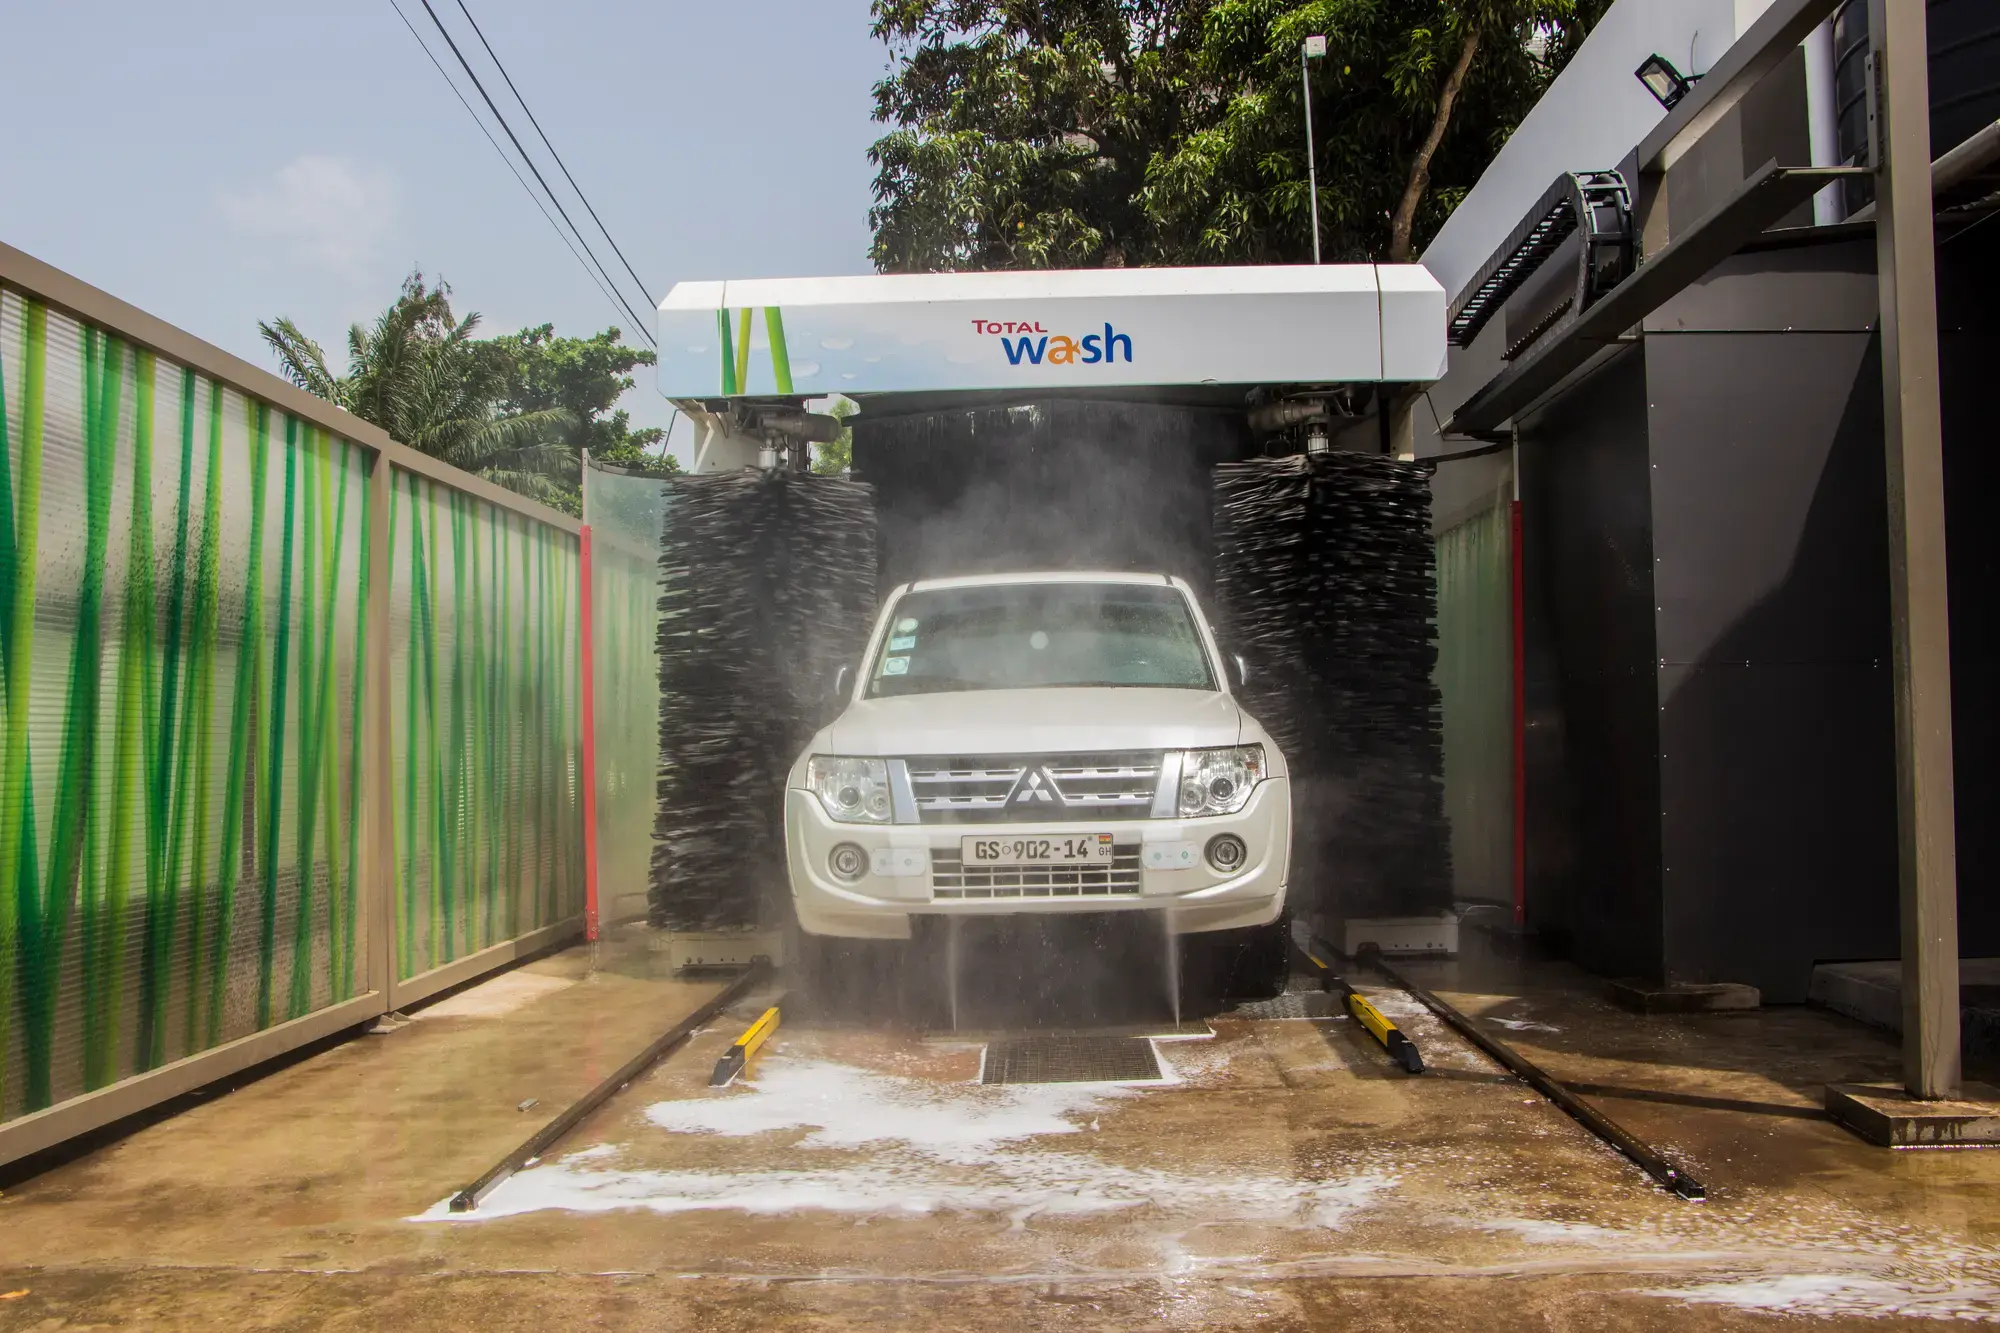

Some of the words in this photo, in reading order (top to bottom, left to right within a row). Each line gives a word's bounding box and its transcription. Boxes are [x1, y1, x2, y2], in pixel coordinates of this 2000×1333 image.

[971, 319, 1048, 335] TOTAL
[1000, 322, 1133, 366] wash
[975, 841, 1000, 860] GS
[1013, 839, 1089, 860] 902-14
[1098, 846, 1112, 856] GH
